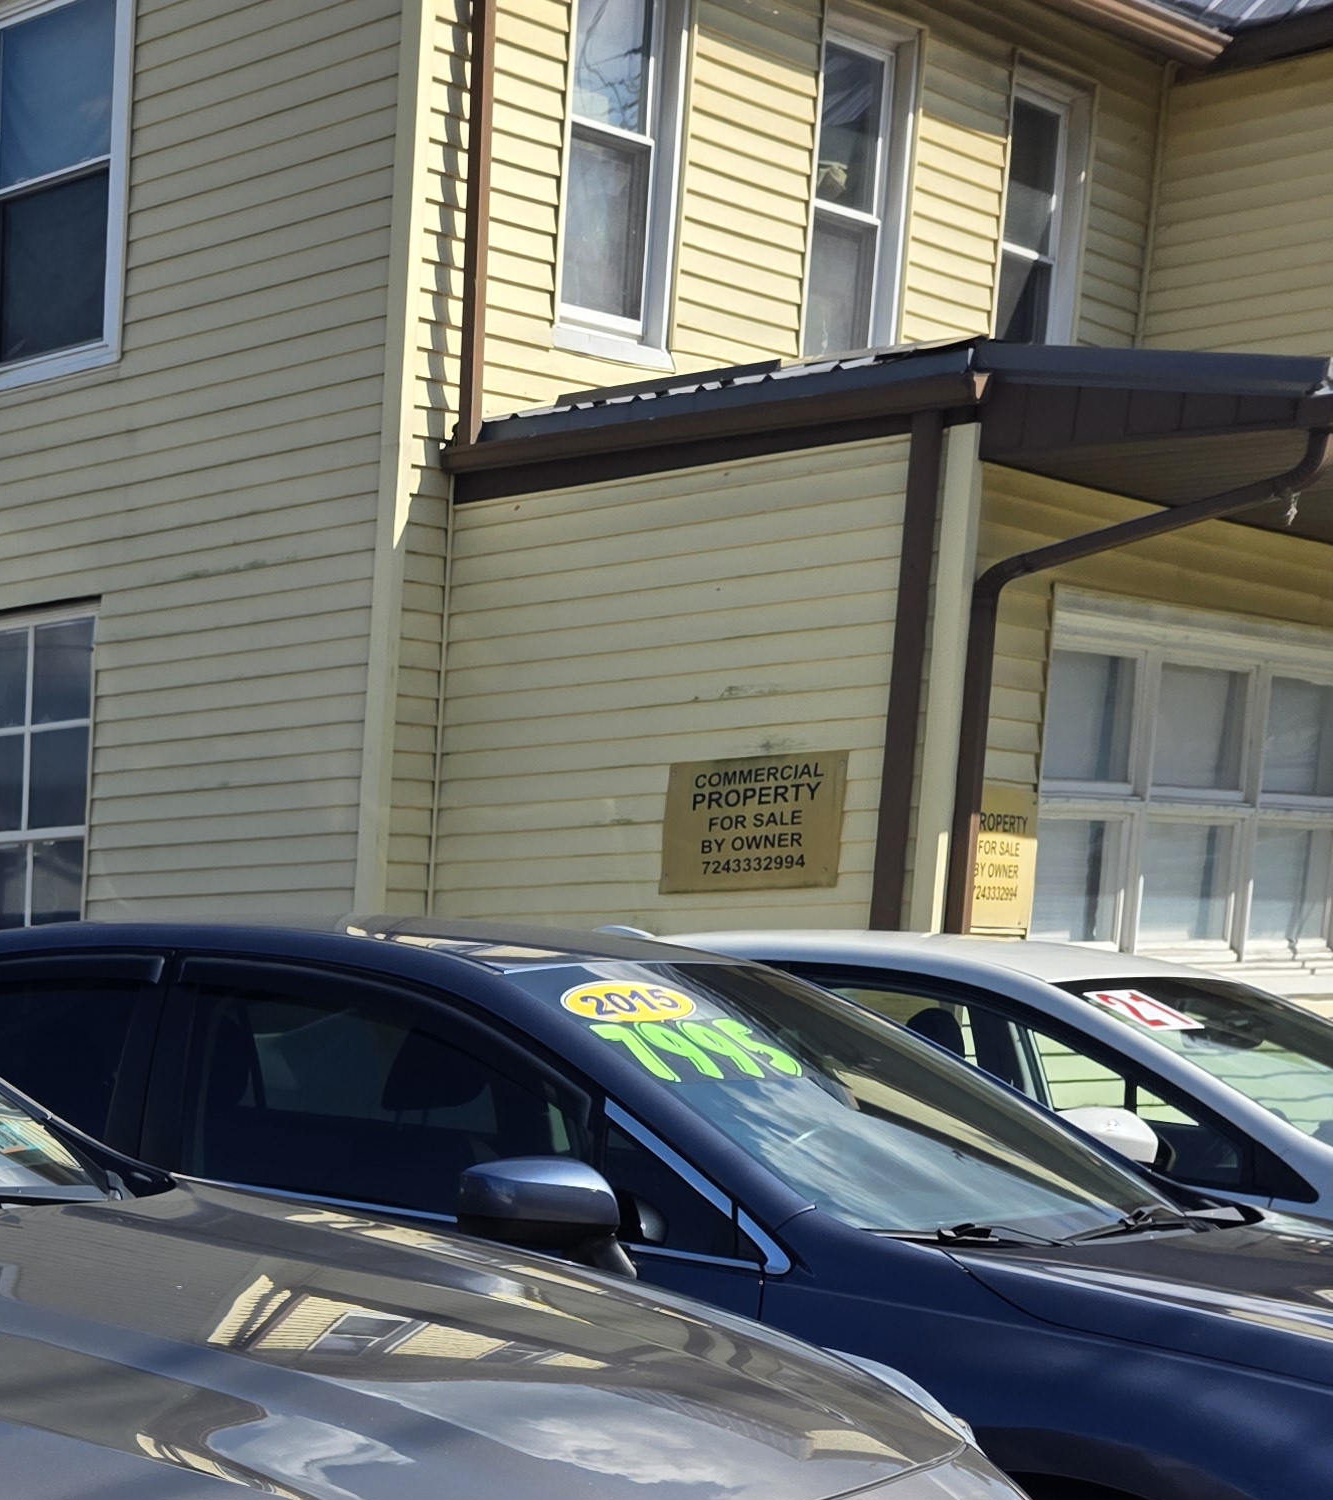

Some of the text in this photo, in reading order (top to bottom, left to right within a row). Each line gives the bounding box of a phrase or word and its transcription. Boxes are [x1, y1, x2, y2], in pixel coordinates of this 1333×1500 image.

[694, 762, 824, 789] COMMERCIAL
[691, 781, 823, 811] PROPERTY
[708, 810, 803, 832] FOR SALE
[980, 812, 1028, 834] ROPERTY
[701, 832, 803, 854] BY OWNER
[978, 840, 1020, 857] FOR SALE
[701, 854, 805, 876] 7243332994
[988, 863, 1019, 879] OWNER
[973, 885, 1018, 901] 243332994
[580, 989, 682, 1017] 2015
[1096, 992, 1194, 1027] 21
[589, 1017, 803, 1083] 7995
